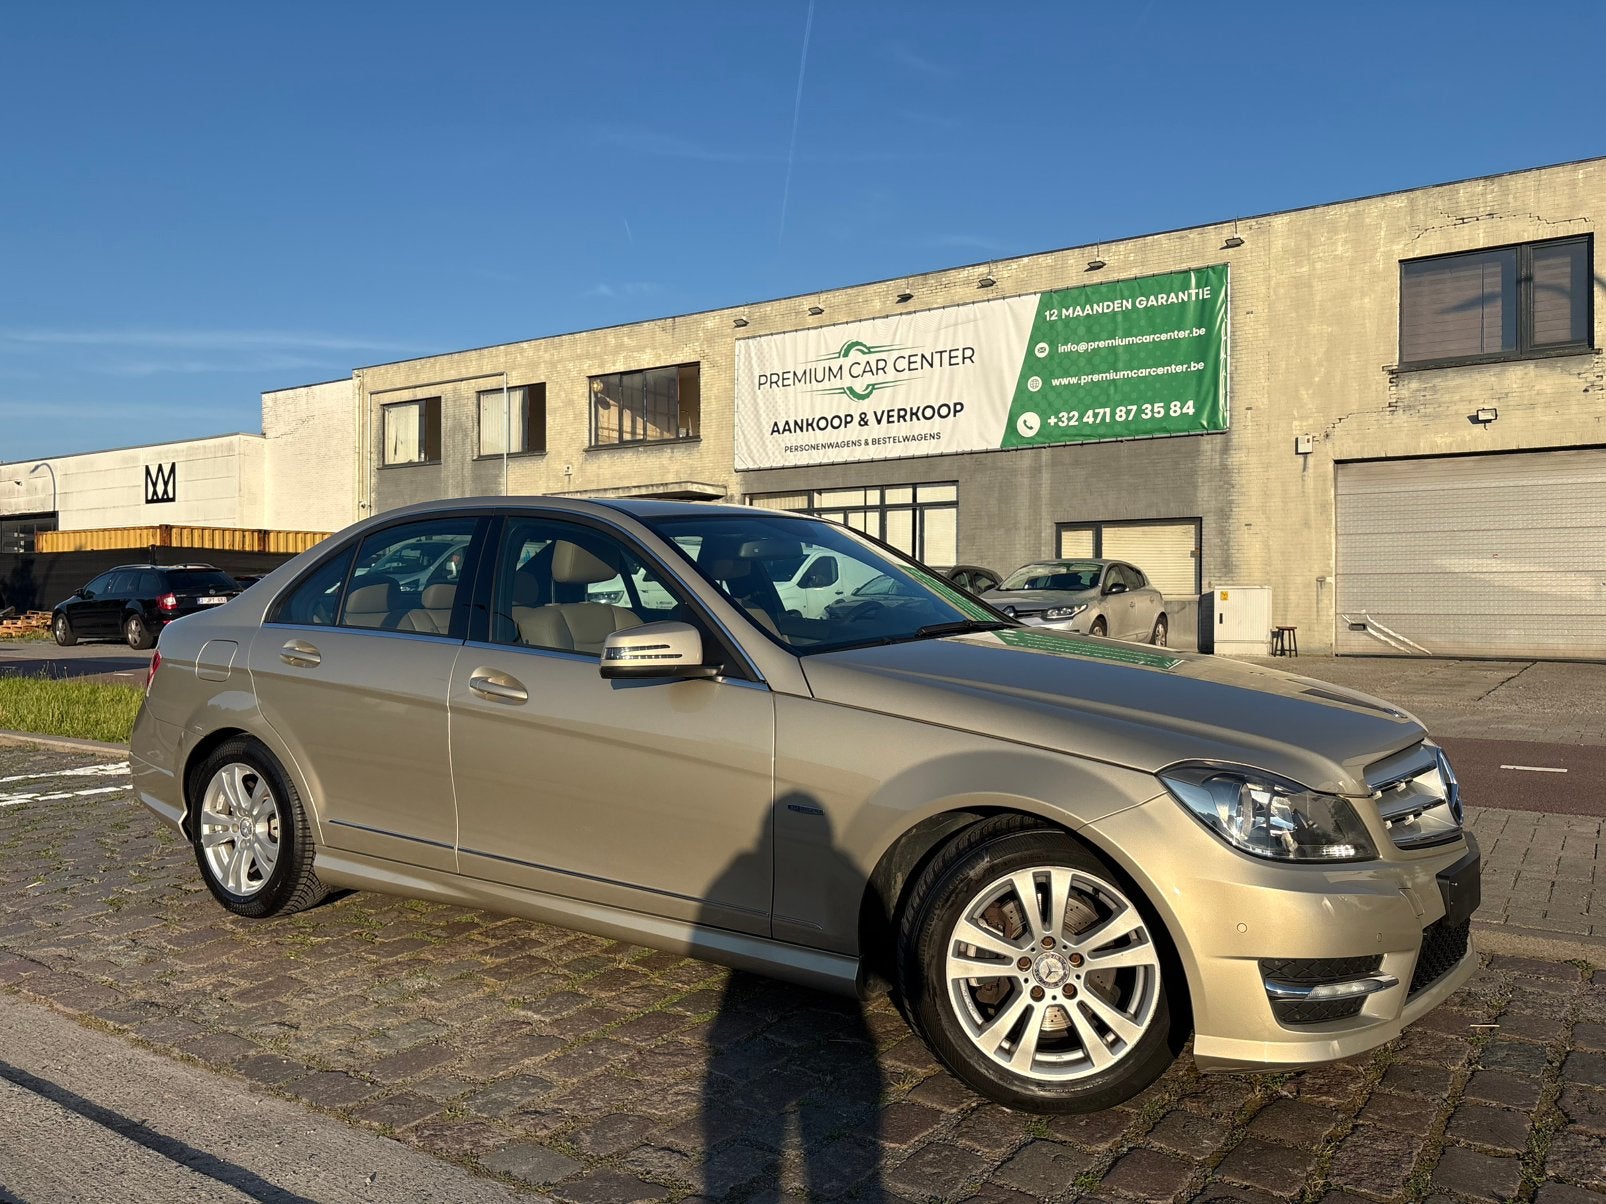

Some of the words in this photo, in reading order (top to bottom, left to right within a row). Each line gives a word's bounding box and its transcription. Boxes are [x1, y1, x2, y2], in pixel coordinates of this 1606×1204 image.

[1045, 309, 1058, 321] 12
[1061, 299, 1132, 319] MAANDEN
[1136, 286, 1211, 308] GARANTIE
[1058, 327, 1206, 353] info@premiumcarcenter.be
[757, 364, 843, 390] PREMIUM
[849, 358, 888, 379] CAR
[893, 346, 975, 373] CENTER
[1051, 361, 1205, 386] www.premiumcarcenter.be
[770, 413, 854, 435] AANKOOP
[857, 411, 870, 427] &
[873, 401, 965, 425] VERKOOP
[1047, 411, 1079, 427] +32
[1082, 408, 1111, 424] 471
[1115, 405, 1137, 421] 87
[1141, 403, 1165, 419] 35
[1169, 400, 1196, 416] 84
[784, 439, 863, 453] PERSONENWAGENS
[864, 438, 870, 446] &
[871, 432, 942, 446] BESTELWAGENS
